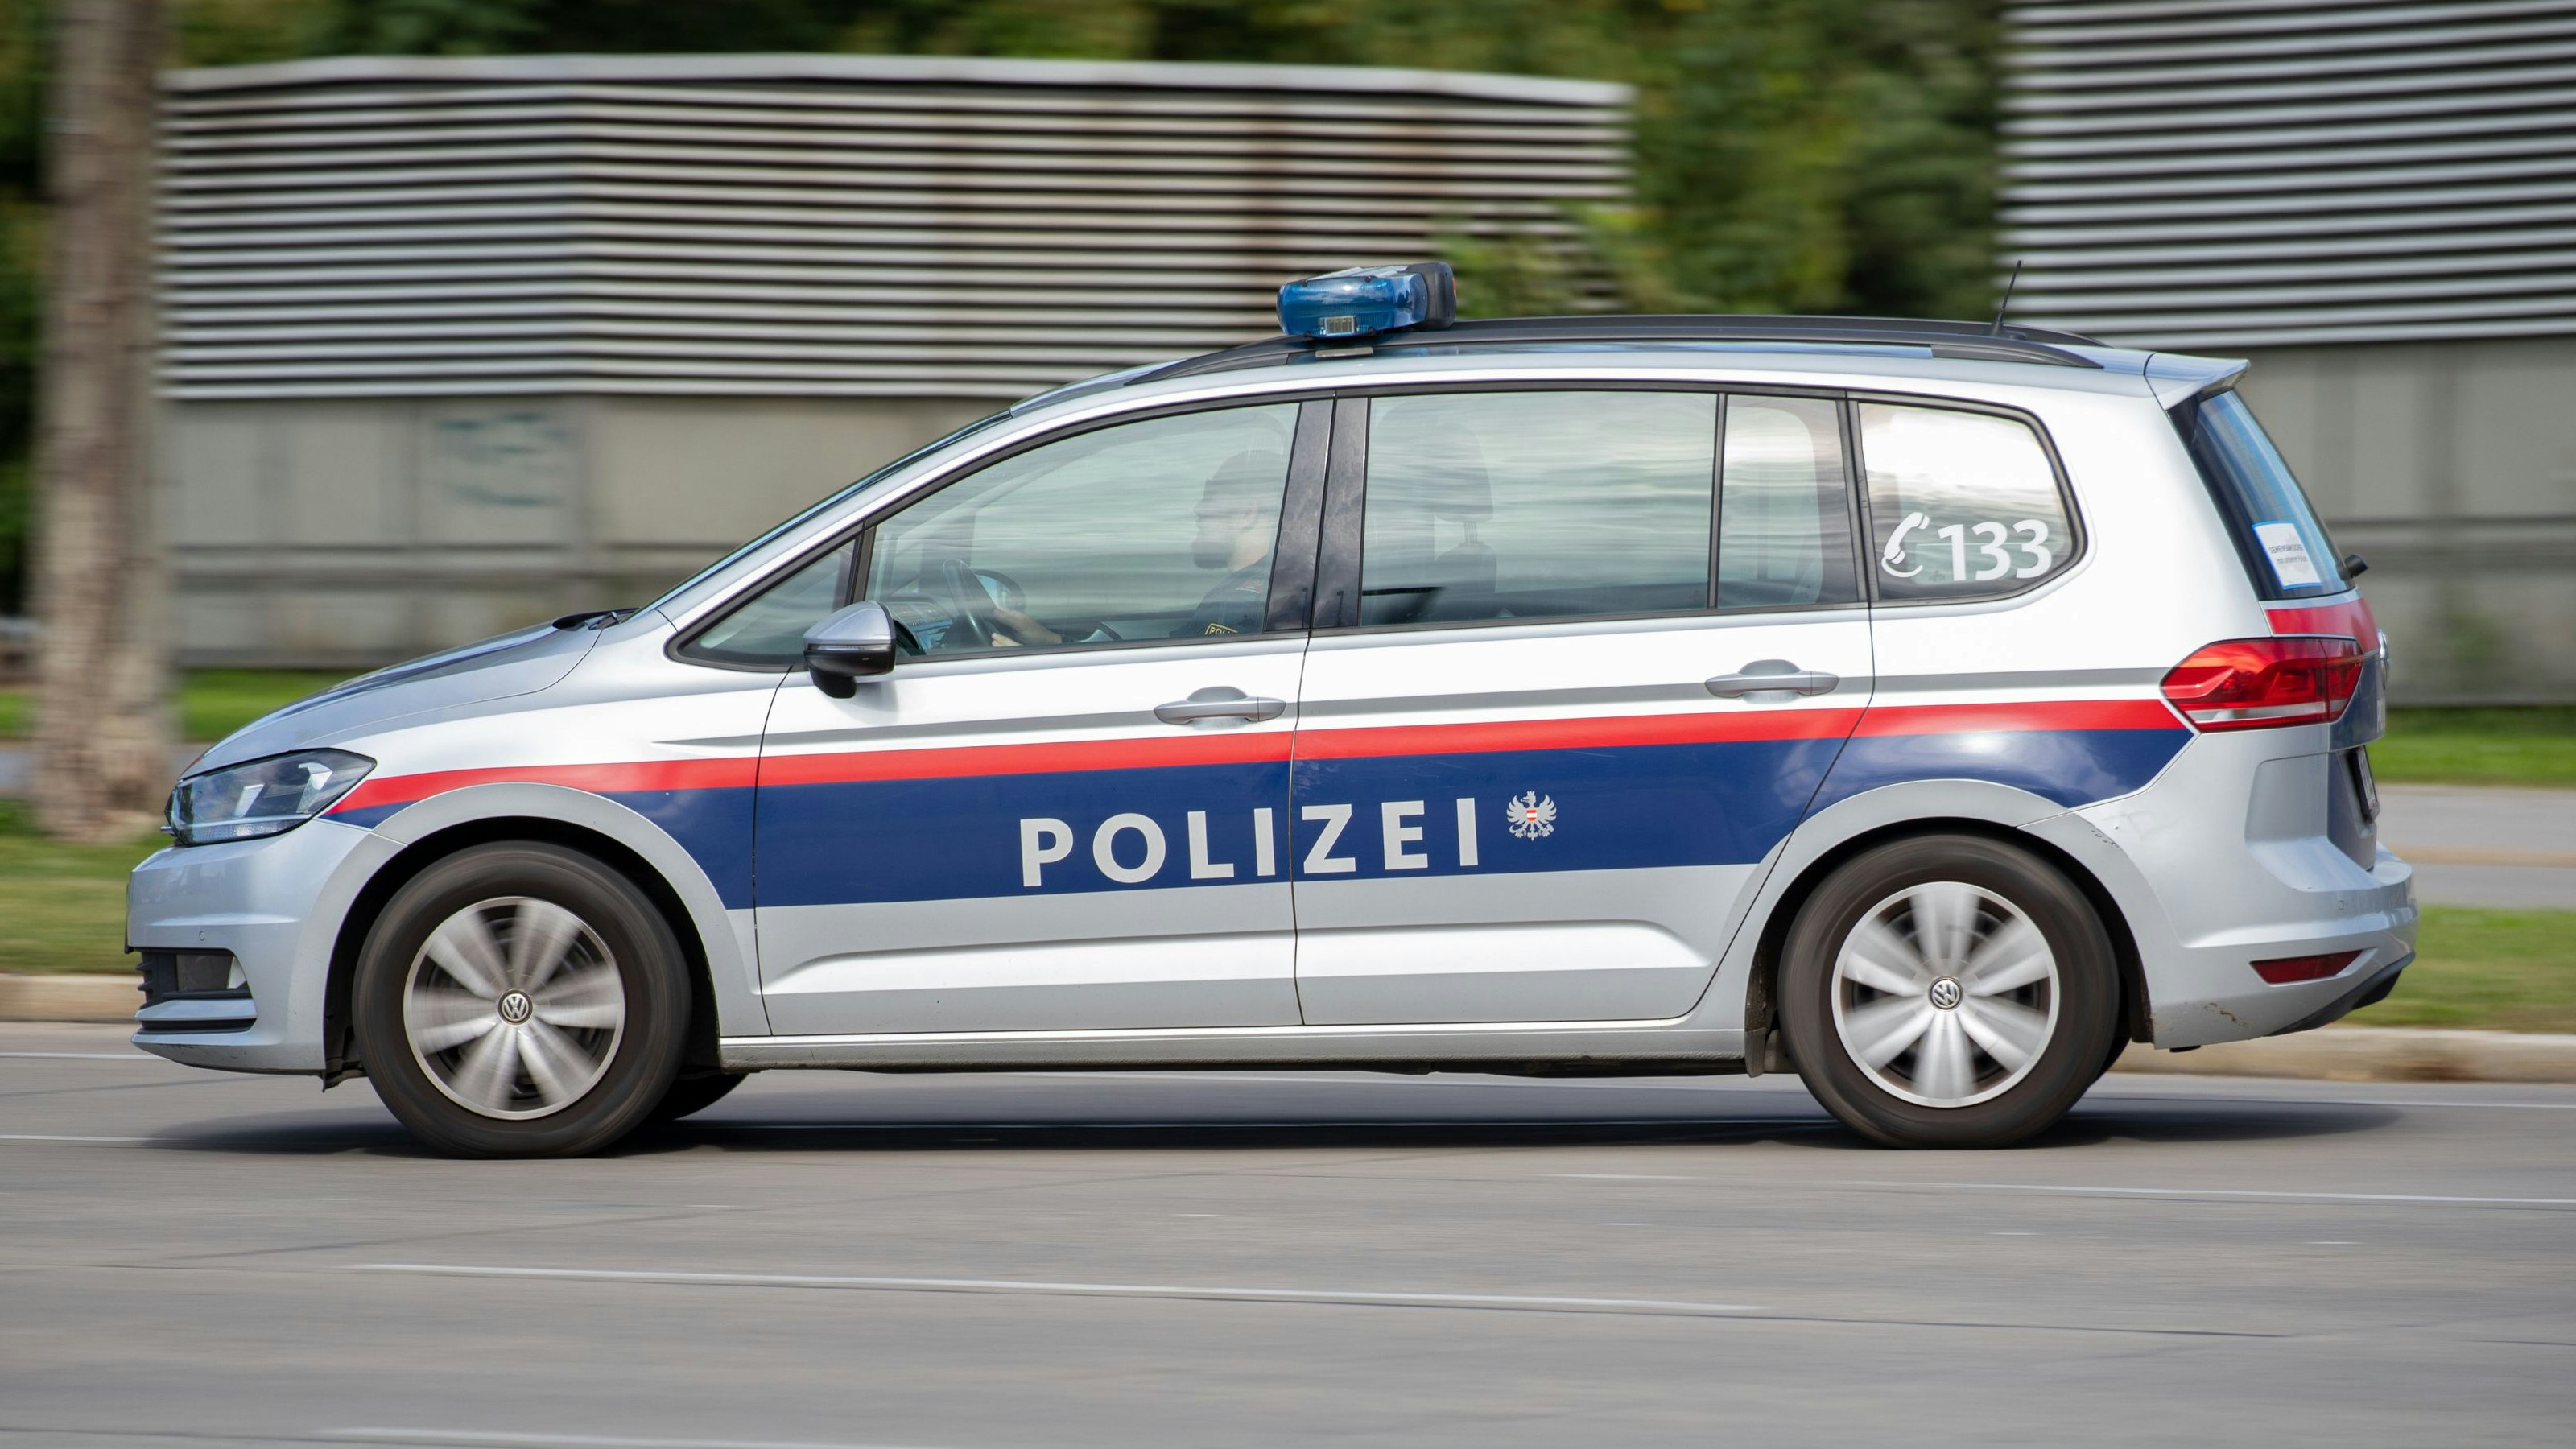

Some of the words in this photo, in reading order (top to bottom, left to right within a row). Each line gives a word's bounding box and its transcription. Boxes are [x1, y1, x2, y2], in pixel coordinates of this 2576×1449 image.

[1938, 519, 2052, 581] 133
[1020, 797, 1479, 887] POLIZEI
[502, 993, 529, 1022] VW
